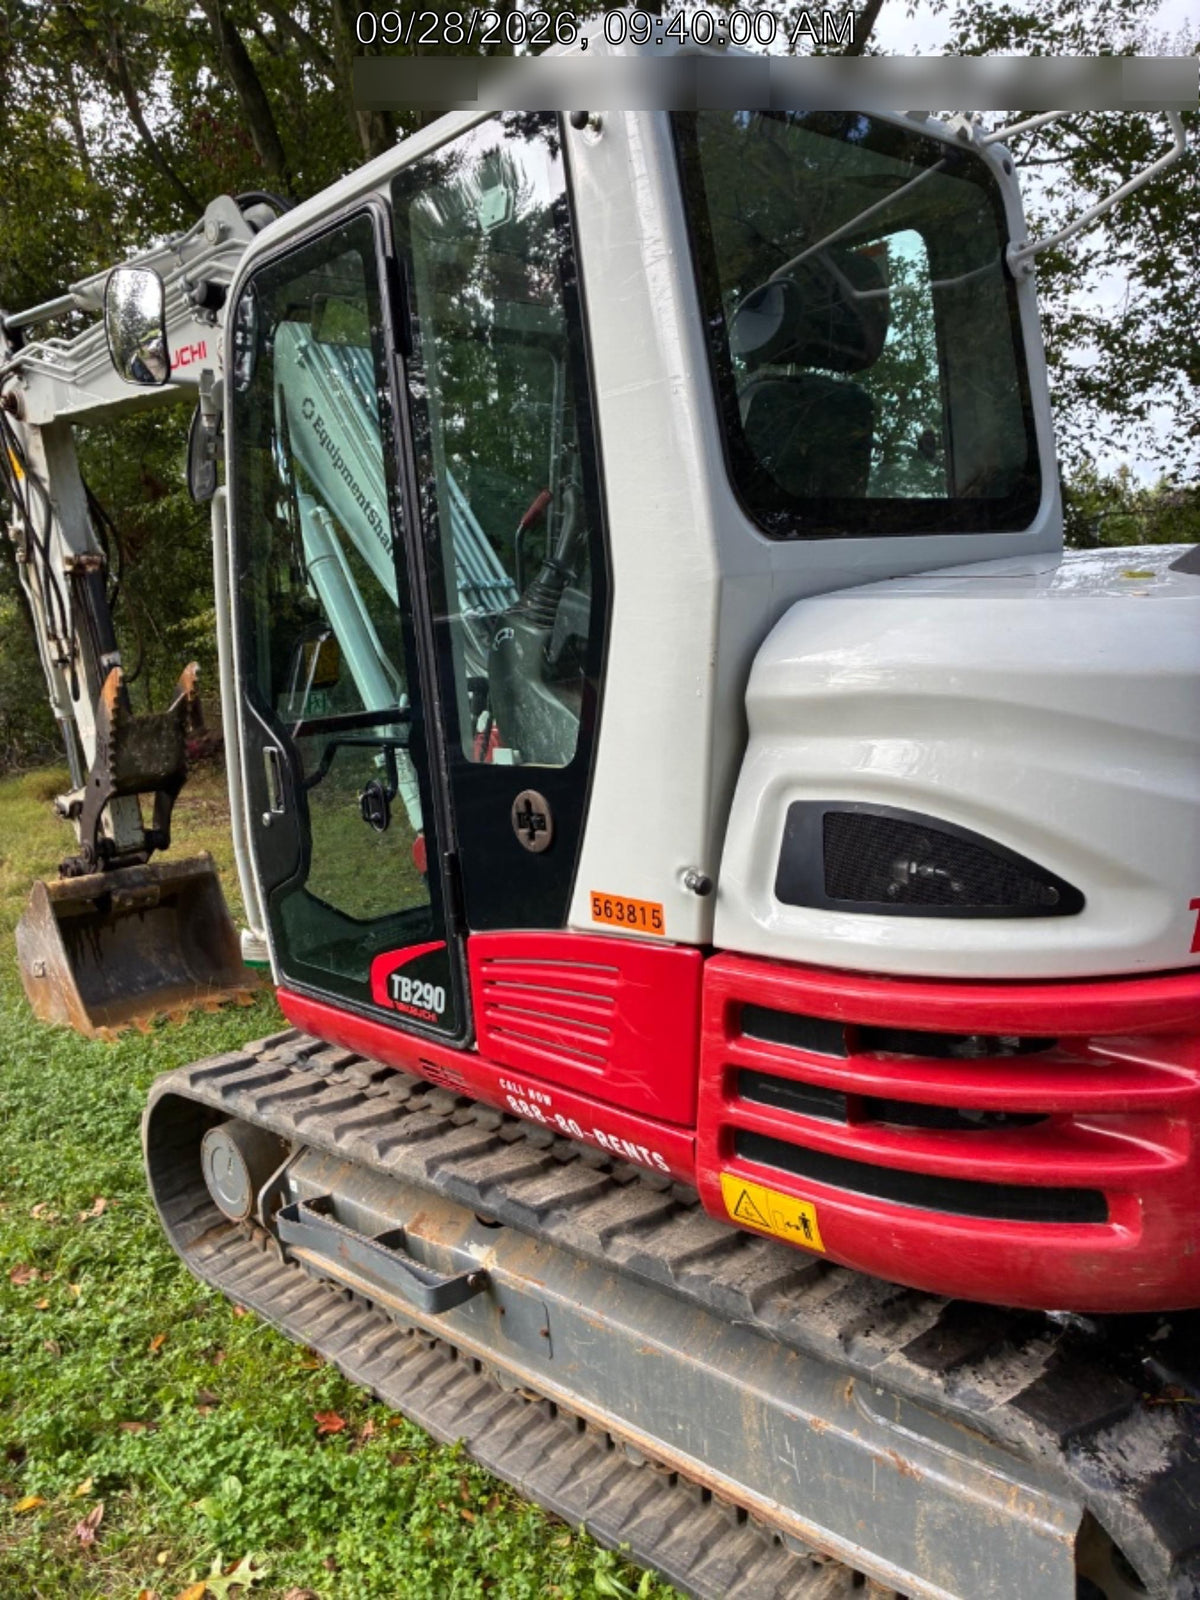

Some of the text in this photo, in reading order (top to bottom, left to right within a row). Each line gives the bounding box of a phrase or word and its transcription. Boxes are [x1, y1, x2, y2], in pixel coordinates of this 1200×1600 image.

[592, 897, 663, 929] 563815
[390, 973, 446, 1015] TB290
[499, 1078, 552, 1107] CALL NOW
[505, 1094, 672, 1173] 888-80-RENTS
